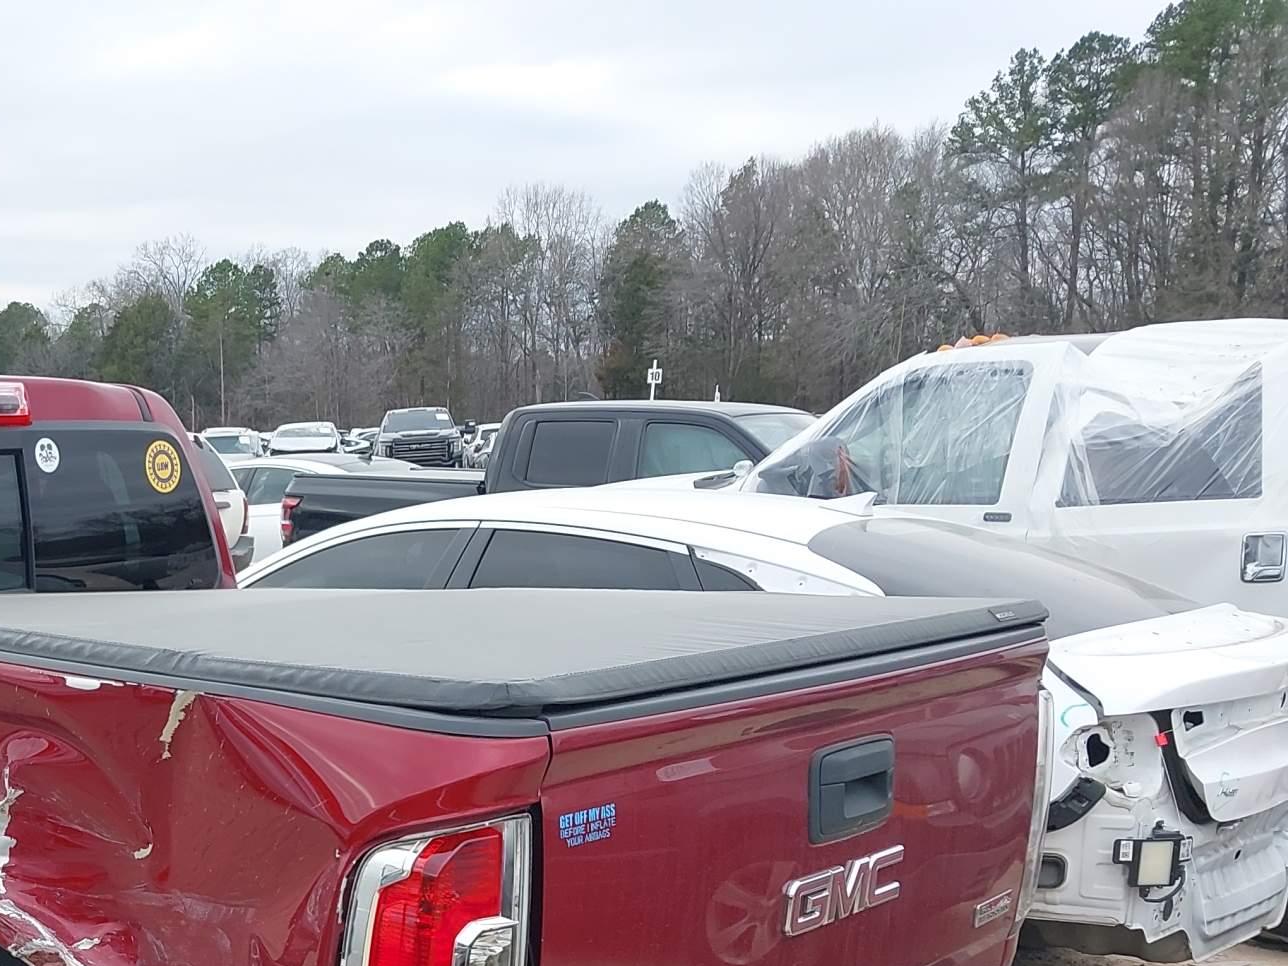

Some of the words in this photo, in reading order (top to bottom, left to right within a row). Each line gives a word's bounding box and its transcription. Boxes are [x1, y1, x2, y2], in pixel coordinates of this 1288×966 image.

[650, 371, 660, 381] 10
[559, 813, 573, 829] GET
[574, 809, 587, 825] OFF
[588, 807, 600, 822] MY
[601, 803, 616, 819] ASS
[560, 824, 586, 839] BEFORE
[590, 817, 616, 832] INFLATE
[566, 835, 585, 848] YOUR
[584, 828, 611, 843] AIRBAGS
[782, 844, 905, 937] GMC
